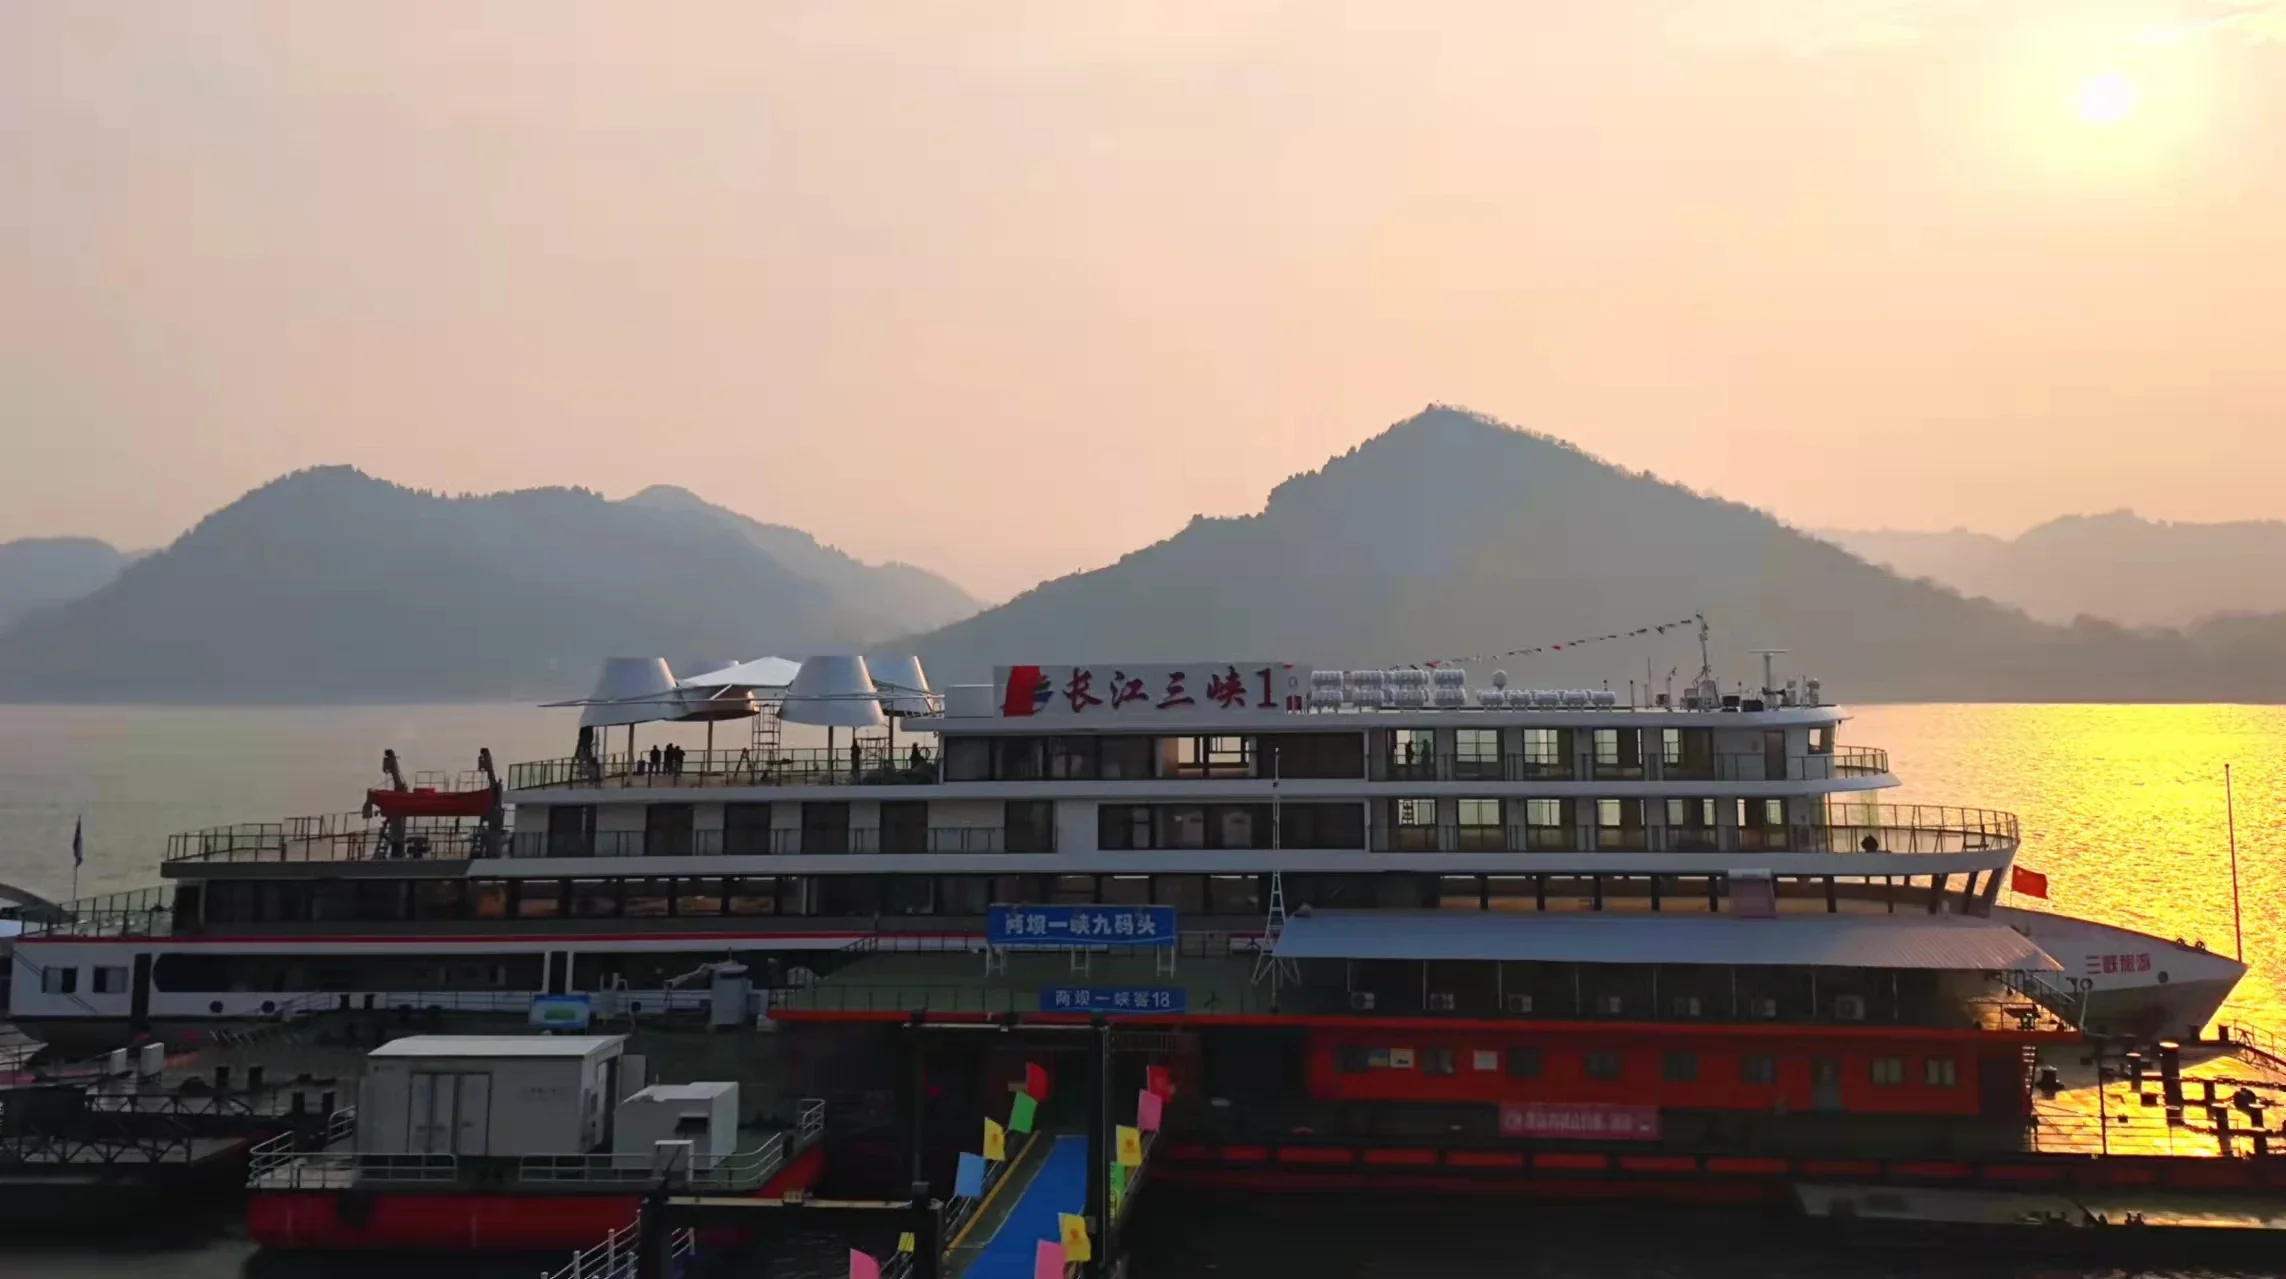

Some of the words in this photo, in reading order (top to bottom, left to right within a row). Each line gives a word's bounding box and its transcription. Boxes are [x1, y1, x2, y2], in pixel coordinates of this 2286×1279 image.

[1062, 665, 1278, 713] 长江三峡1
[1005, 913, 1157, 935] 两坝一峡九码头
